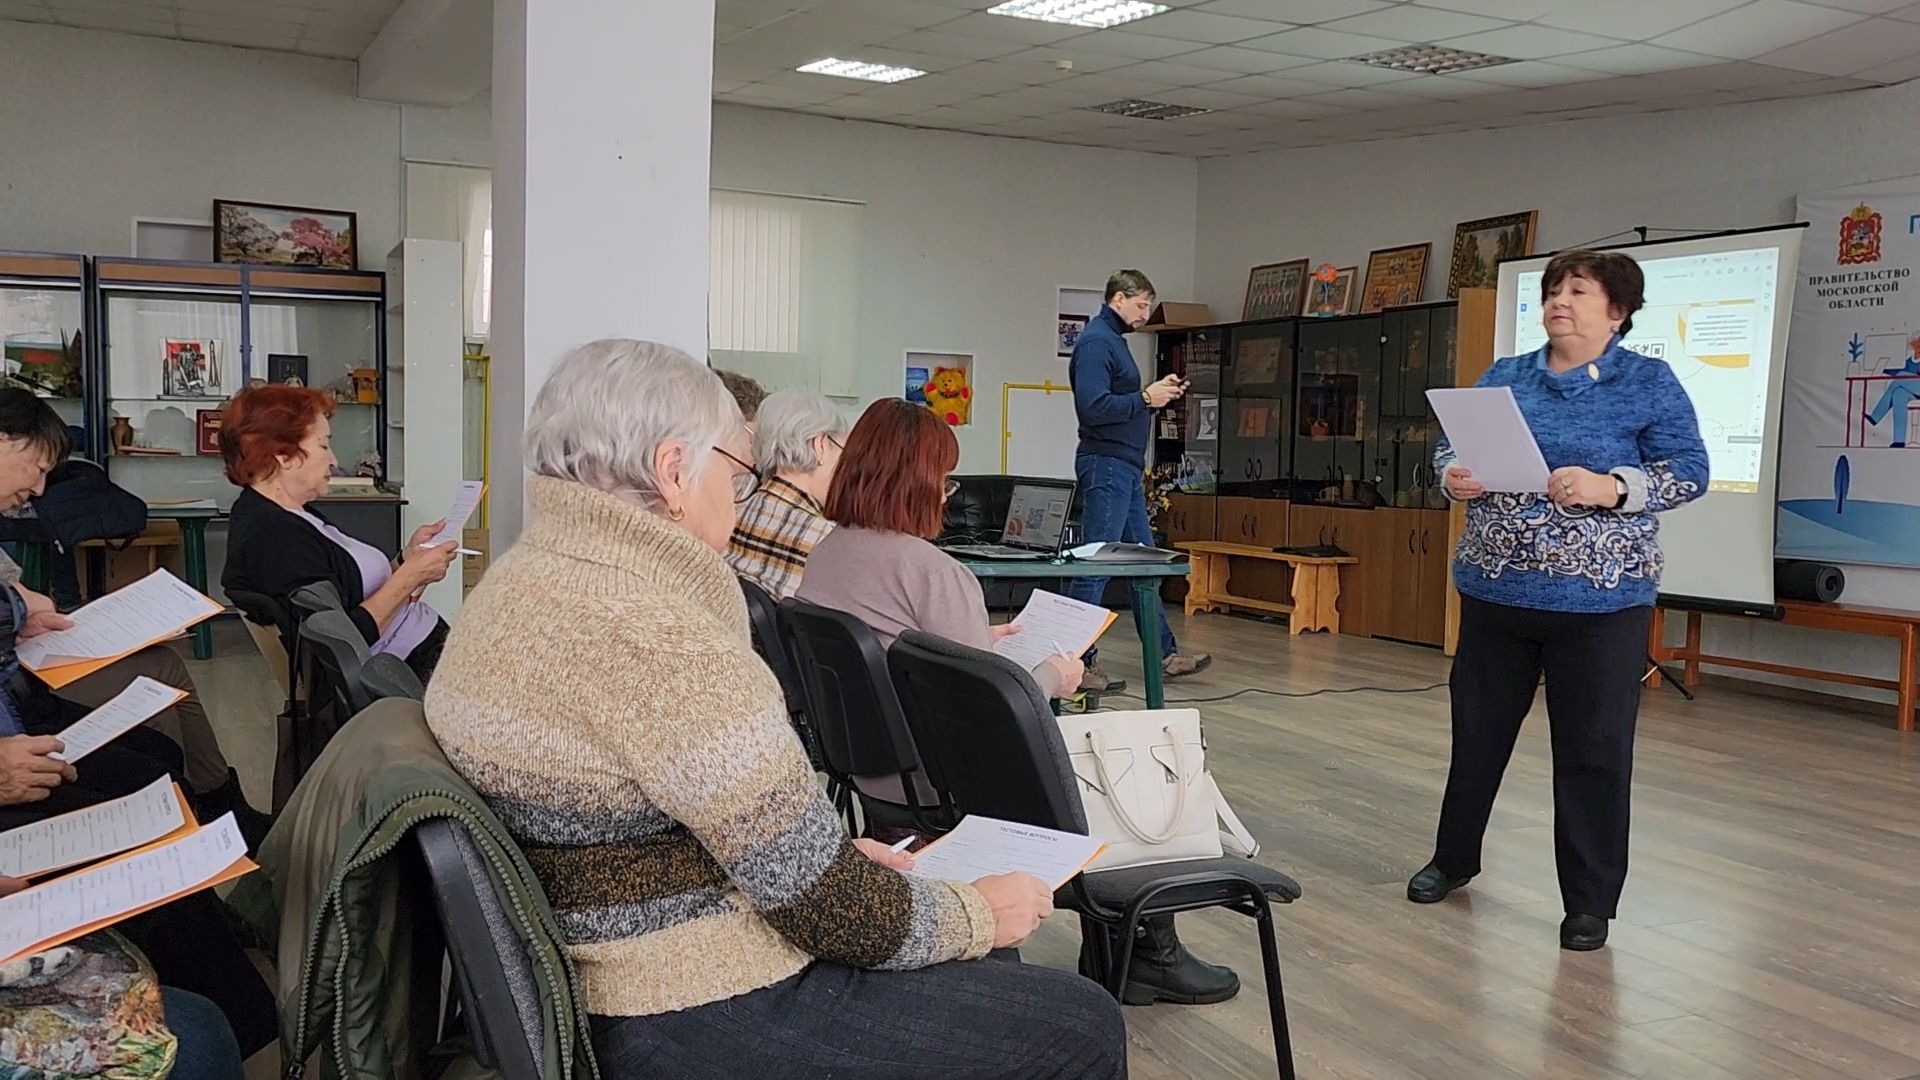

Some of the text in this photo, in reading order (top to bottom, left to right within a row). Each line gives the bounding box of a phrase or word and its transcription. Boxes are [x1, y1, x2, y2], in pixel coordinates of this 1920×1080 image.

[1809, 268, 1910, 286] ПРАВИТЕЛЬСТВО
[1816, 281, 1899, 297] МОСКОВСКОЙ
[1828, 297, 1884, 309] ОБЛАСТИ
